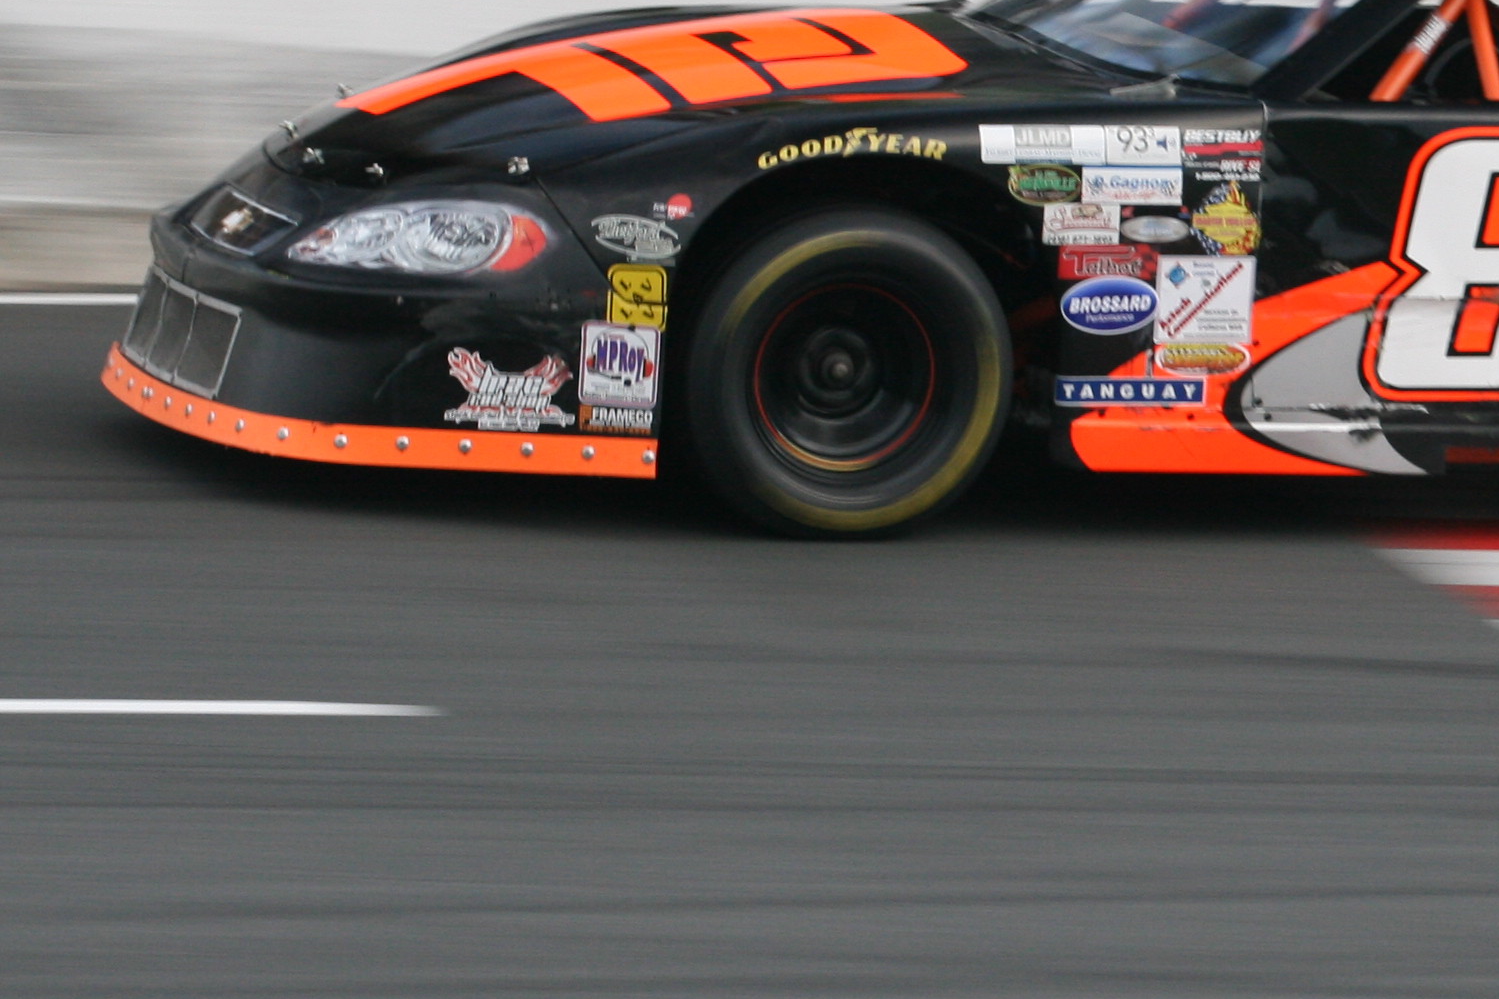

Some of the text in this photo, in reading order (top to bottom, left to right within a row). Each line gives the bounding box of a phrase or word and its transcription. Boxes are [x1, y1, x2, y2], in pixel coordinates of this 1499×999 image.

[757, 127, 949, 171] GOODYEAR
[1068, 294, 1152, 315] BROSSARD
[1062, 383, 1197, 400] TANGUAY
